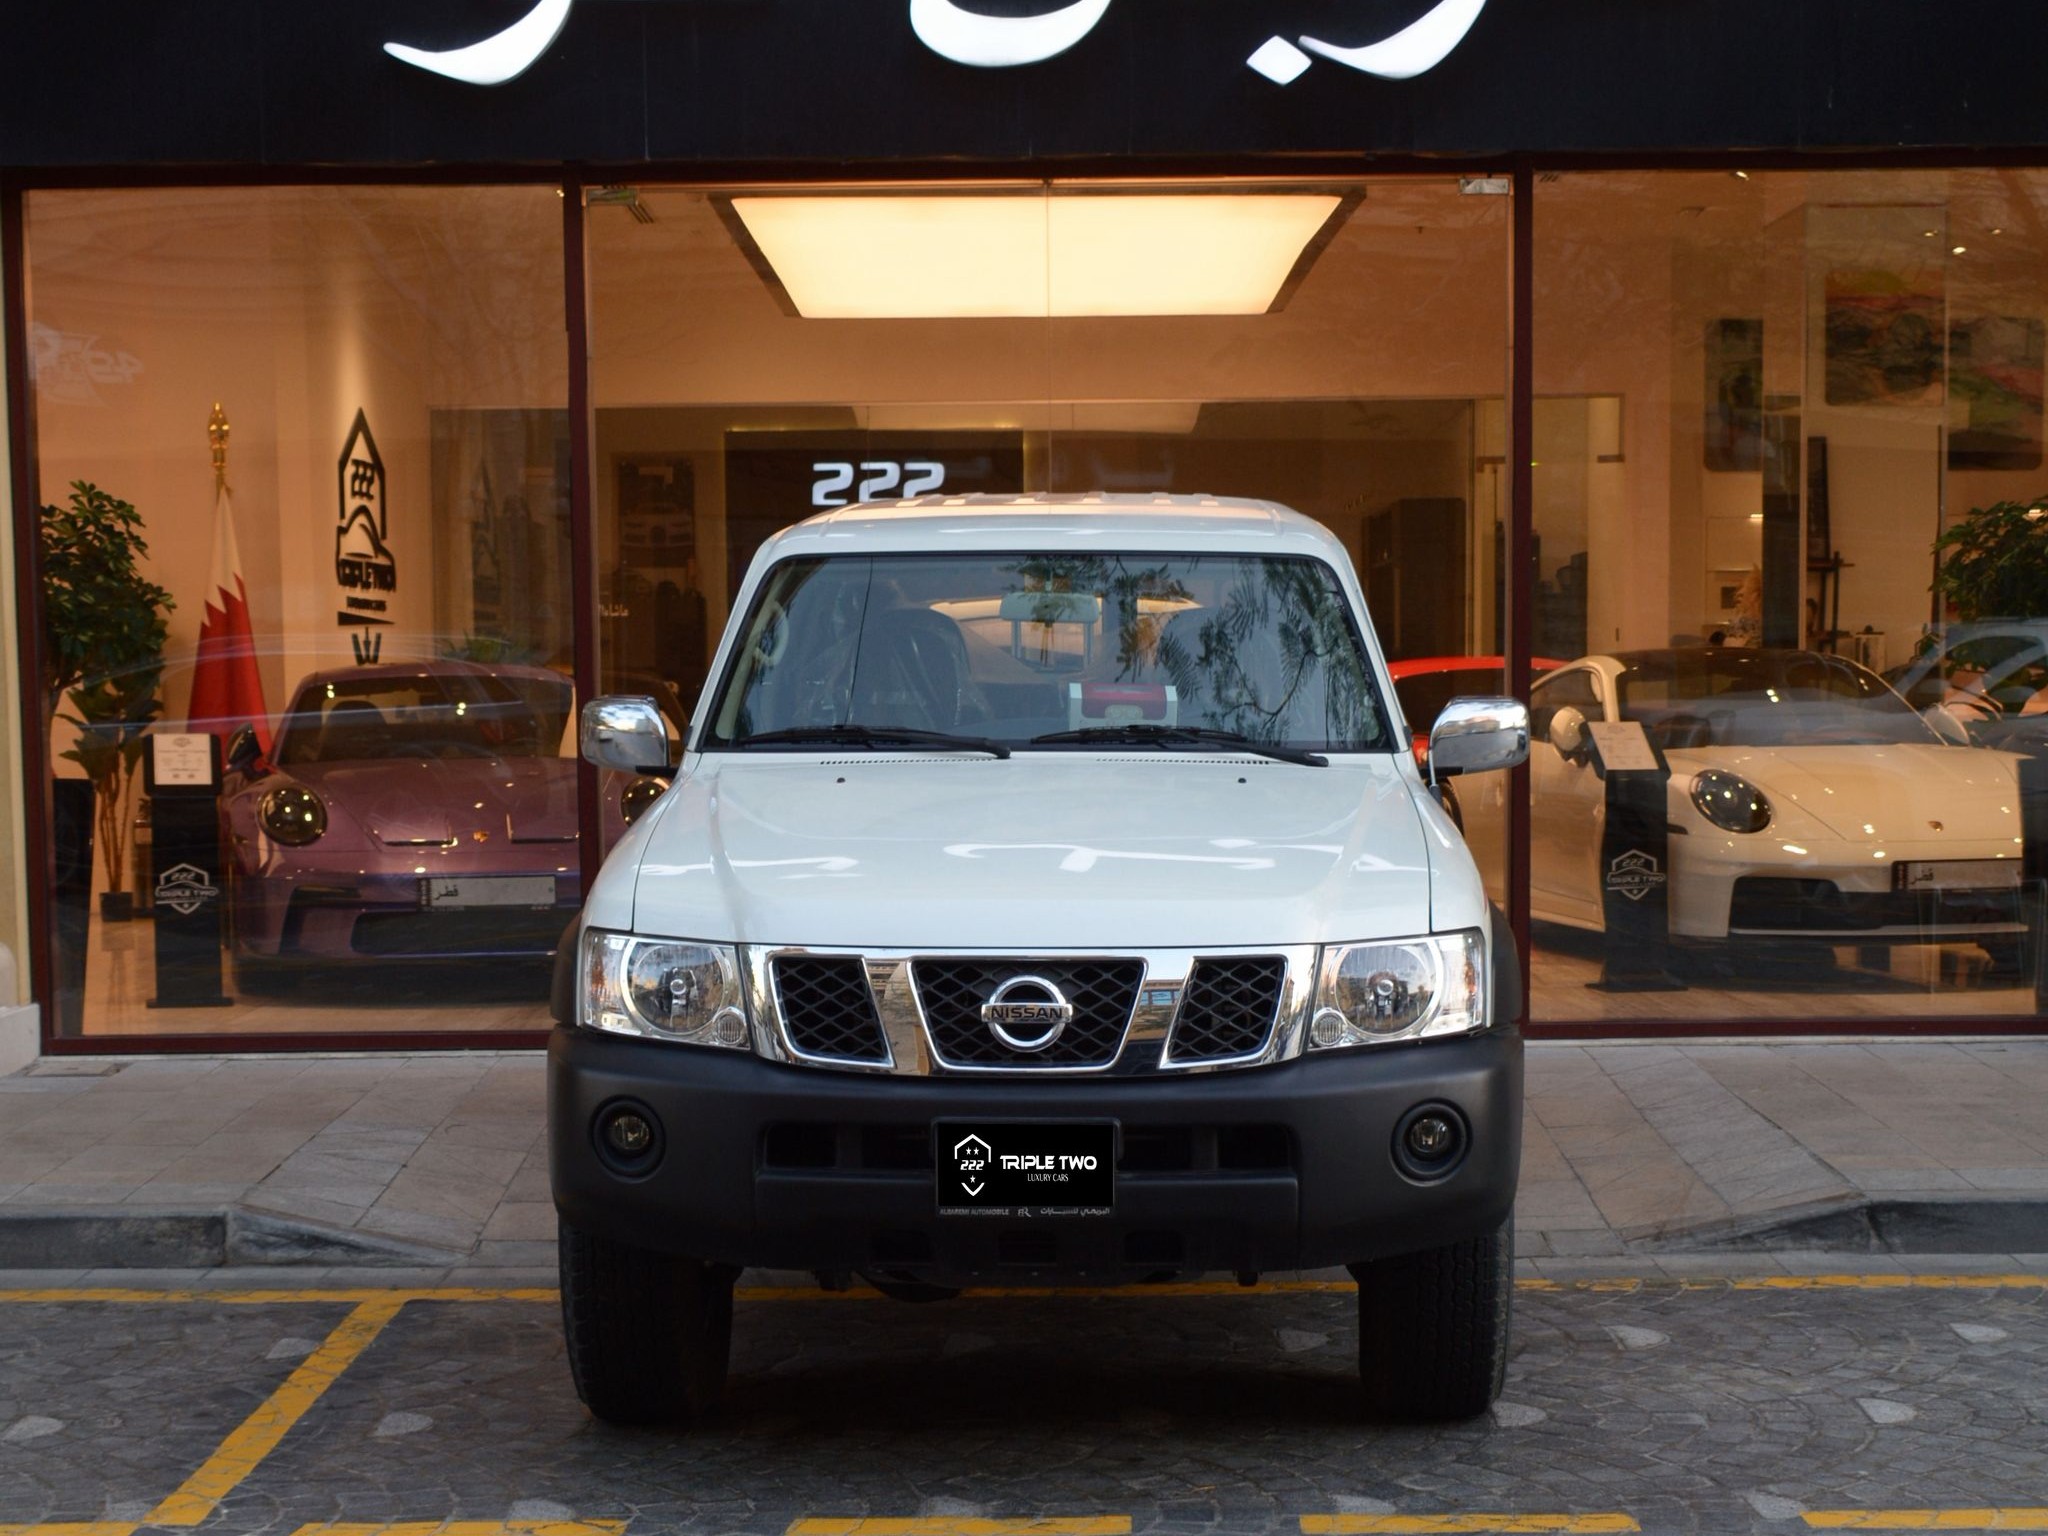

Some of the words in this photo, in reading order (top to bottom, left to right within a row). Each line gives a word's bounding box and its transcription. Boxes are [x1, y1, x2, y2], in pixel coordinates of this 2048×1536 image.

[811, 461, 945, 506] 222
[991, 1007, 1062, 1019] NISSAN
[971, 1208, 1009, 1216] AUTOMOBILE
